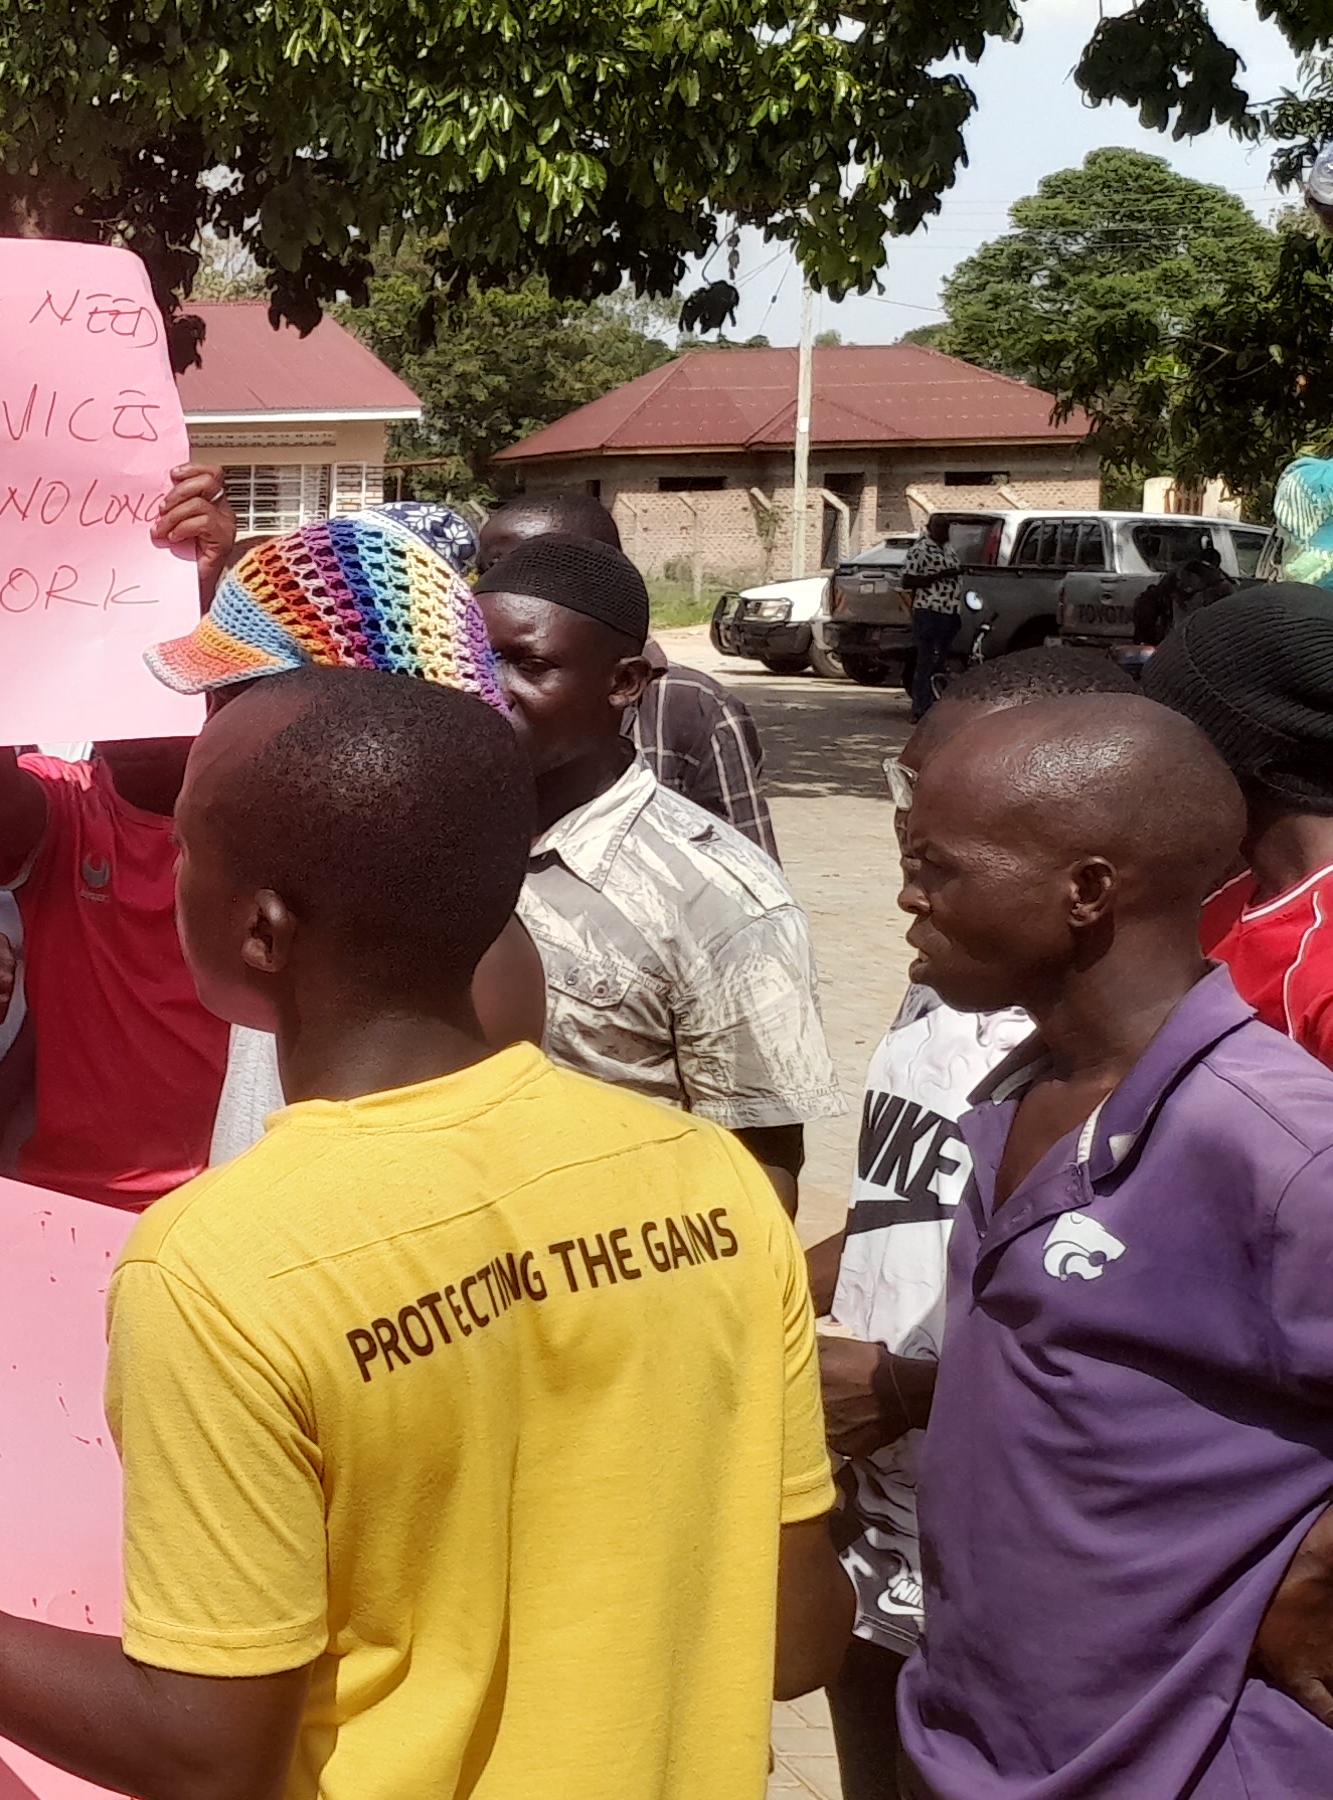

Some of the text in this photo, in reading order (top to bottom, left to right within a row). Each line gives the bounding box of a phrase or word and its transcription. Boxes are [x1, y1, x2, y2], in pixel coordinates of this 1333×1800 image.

[28, 288, 160, 349] NEED
[1078, 603, 1136, 625] TOYOT
[345, 1250, 548, 1384] PROTECTING
[548, 1227, 642, 1292] THE
